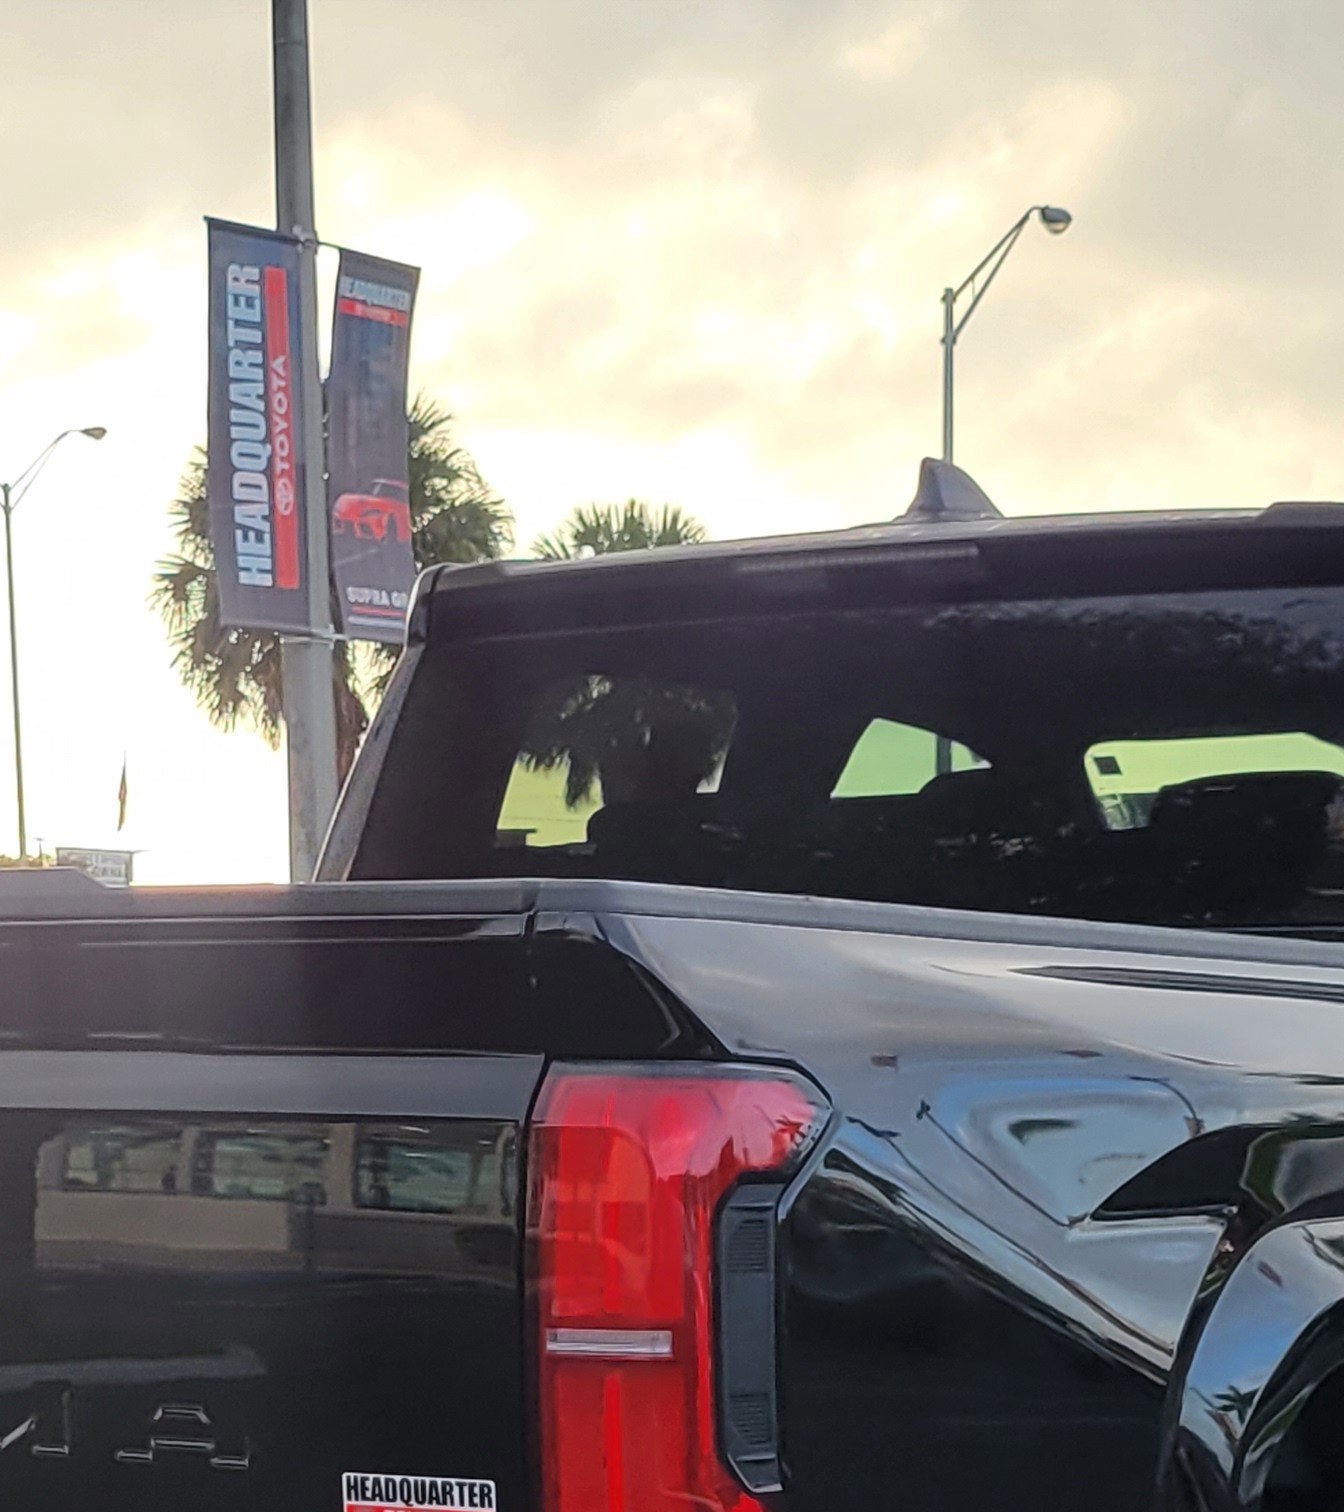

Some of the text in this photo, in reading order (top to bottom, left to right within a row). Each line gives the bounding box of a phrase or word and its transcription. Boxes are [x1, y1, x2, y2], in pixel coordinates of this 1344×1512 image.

[226, 263, 274, 588] HEADQUARTER
[271, 355, 291, 471] TOYOTA
[345, 1474, 494, 1508] HEADQUARTER
